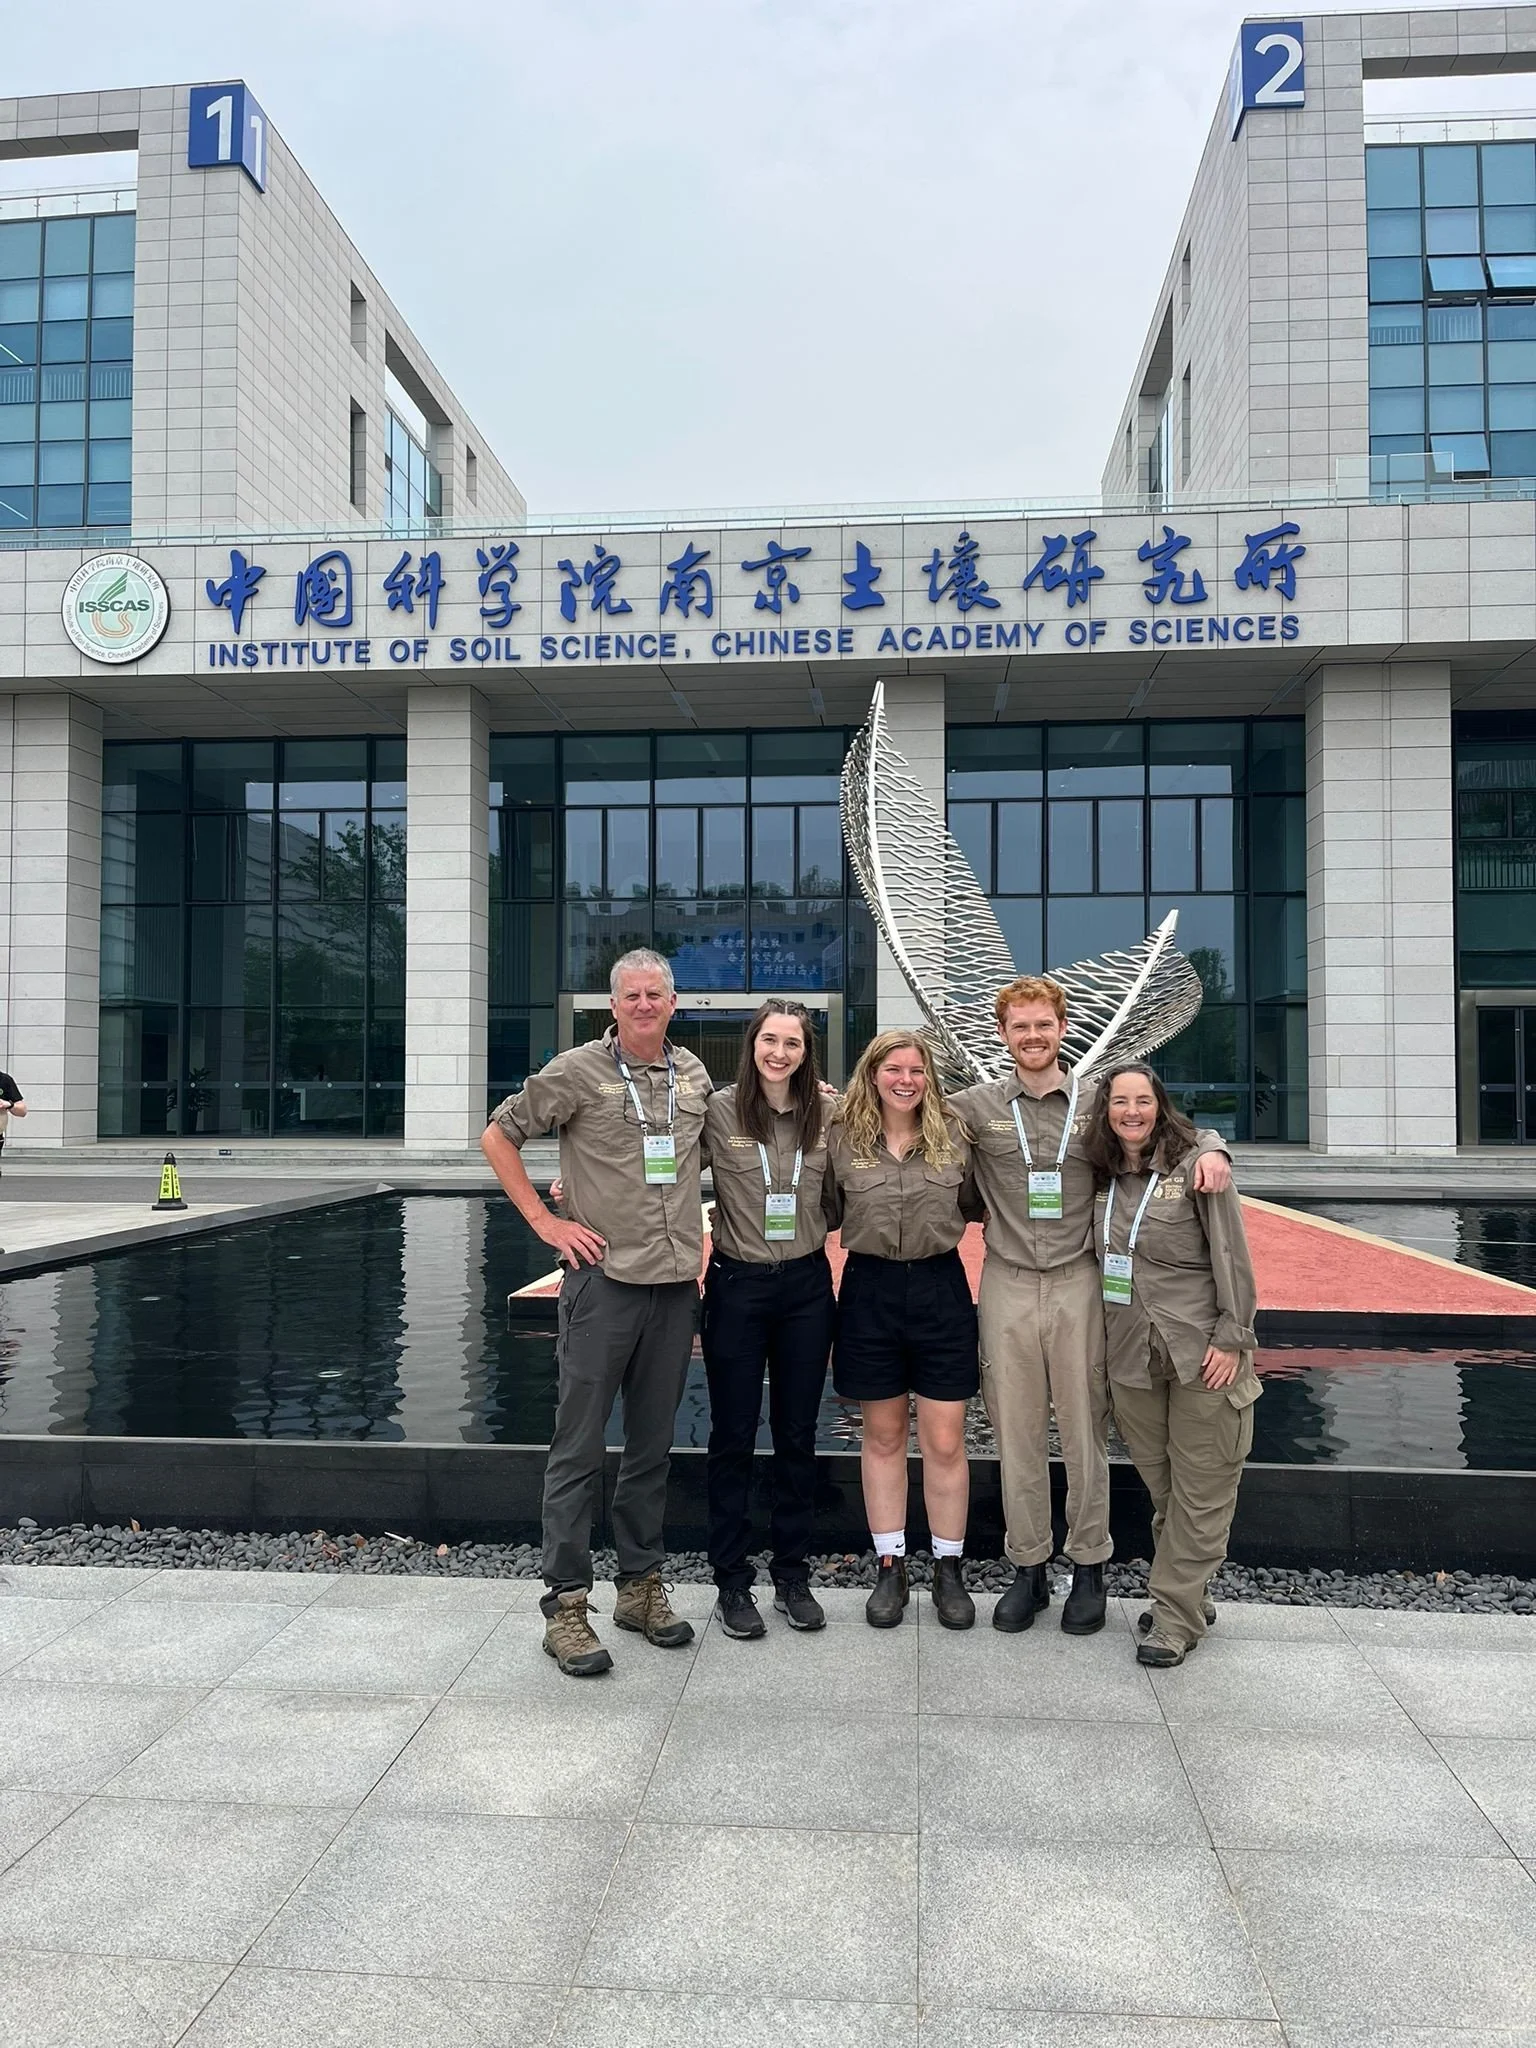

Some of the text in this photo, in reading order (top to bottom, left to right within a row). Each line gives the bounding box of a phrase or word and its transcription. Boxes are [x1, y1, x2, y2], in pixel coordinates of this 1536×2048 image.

[1254, 33, 1305, 103] 2
[206, 95, 233, 160] 1
[250, 115, 263, 184] 1
[79, 599, 150, 613] ISSCAS
[208, 614, 1300, 667] INSTITUTE OF SOIL SCIENCE, CHINESE ACADEMY OF SCIENCES
